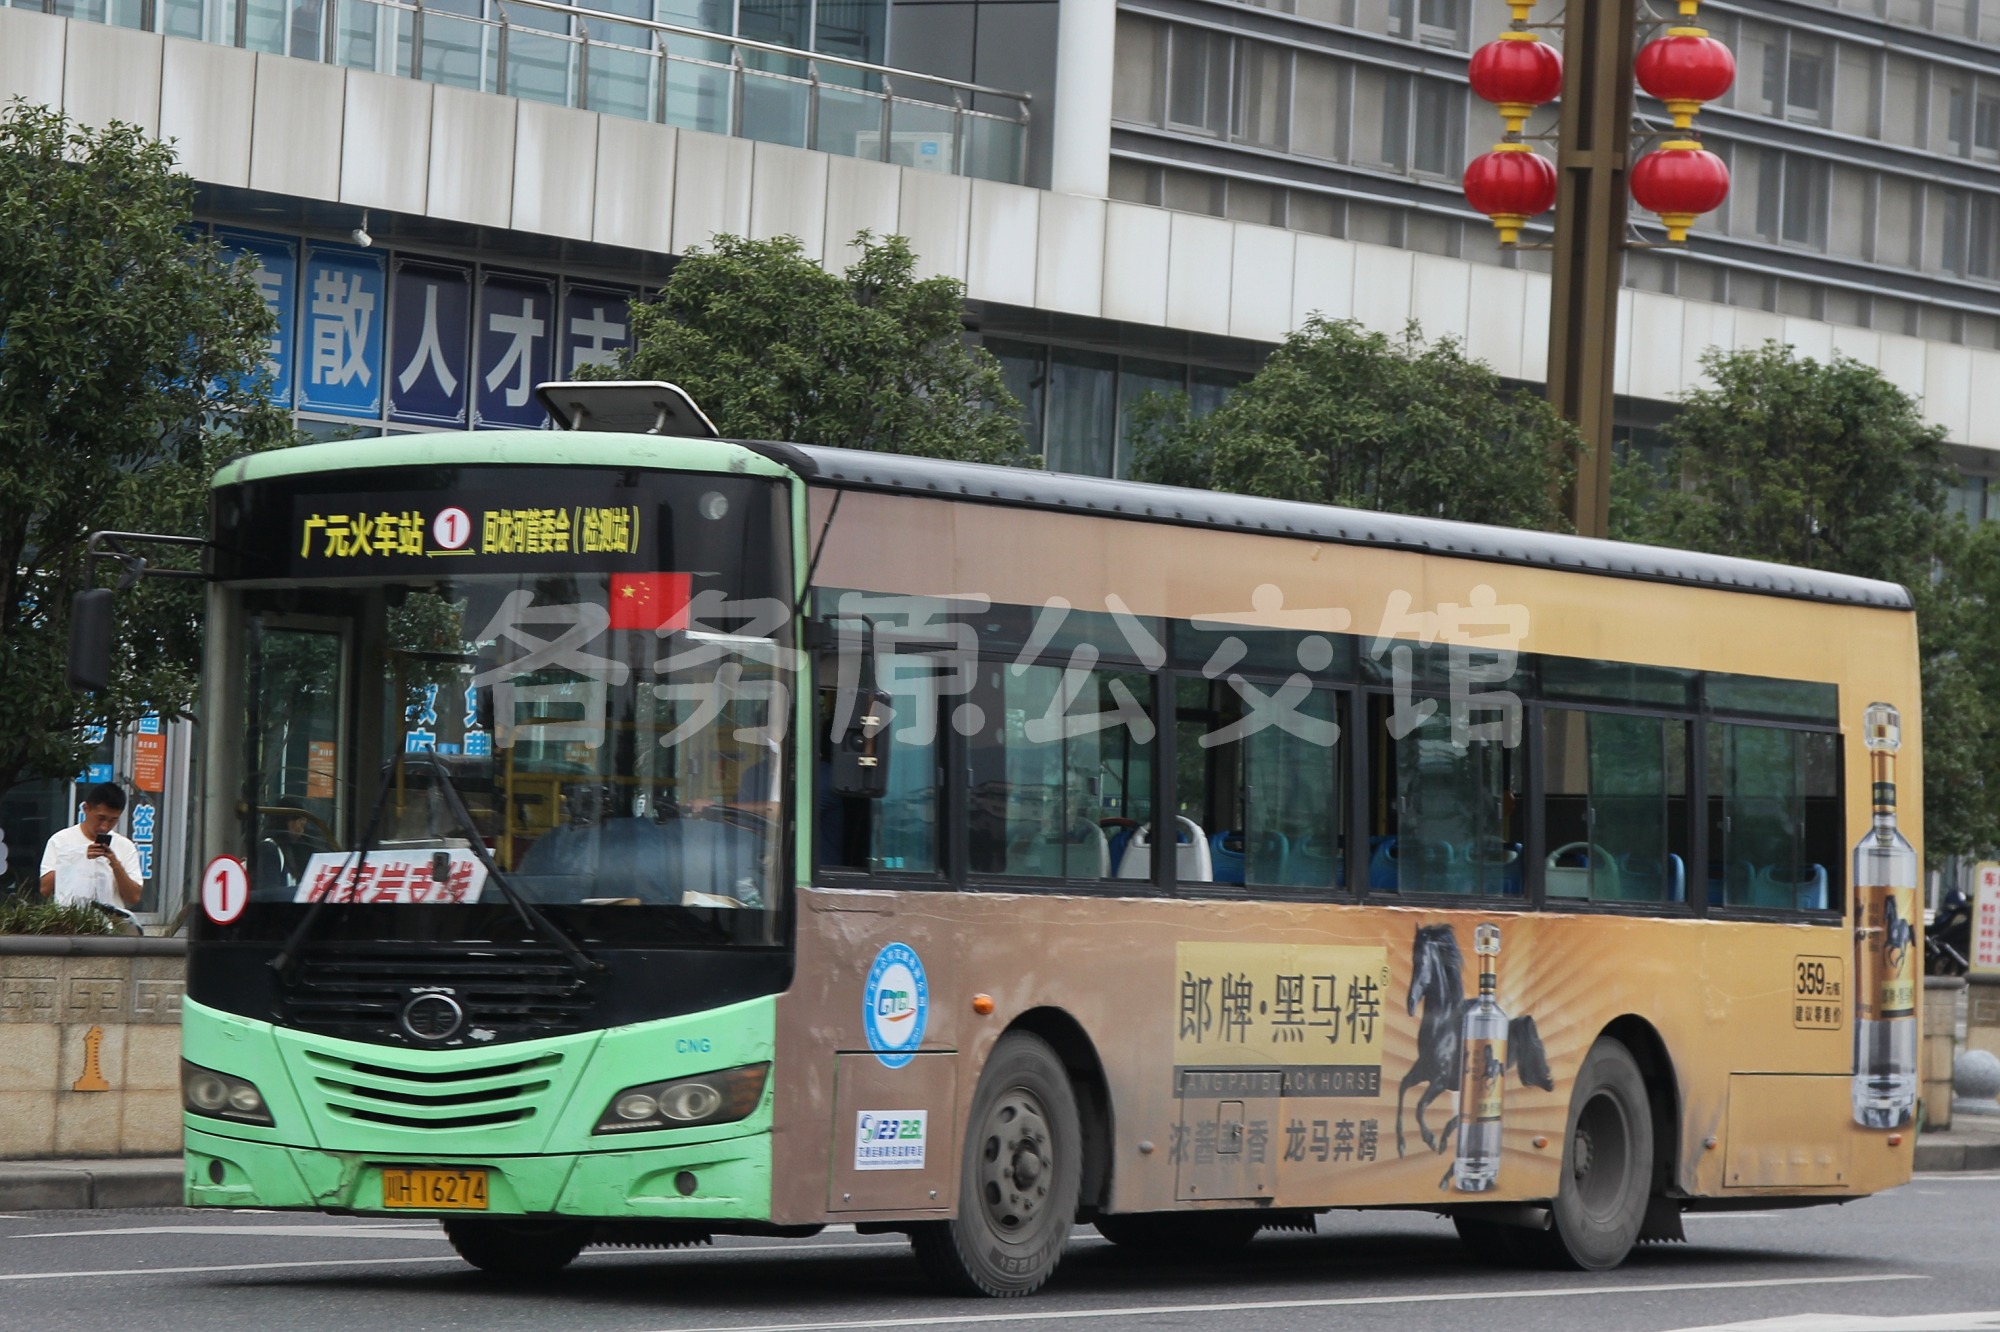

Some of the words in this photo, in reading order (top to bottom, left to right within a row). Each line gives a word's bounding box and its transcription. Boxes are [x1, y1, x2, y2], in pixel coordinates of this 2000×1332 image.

[301, 511, 425, 558] 广元火车站
[1179, 971, 1380, 1044] 郎牌·黑马特
[676, 1038, 711, 1054] CNG
[1229, 1073, 1256, 1090] PAI
[1262, 1072, 1316, 1091] BLACK
[1321, 1072, 1377, 1090] HORSE
[1284, 1118, 1379, 1163] 龙马奔腾
